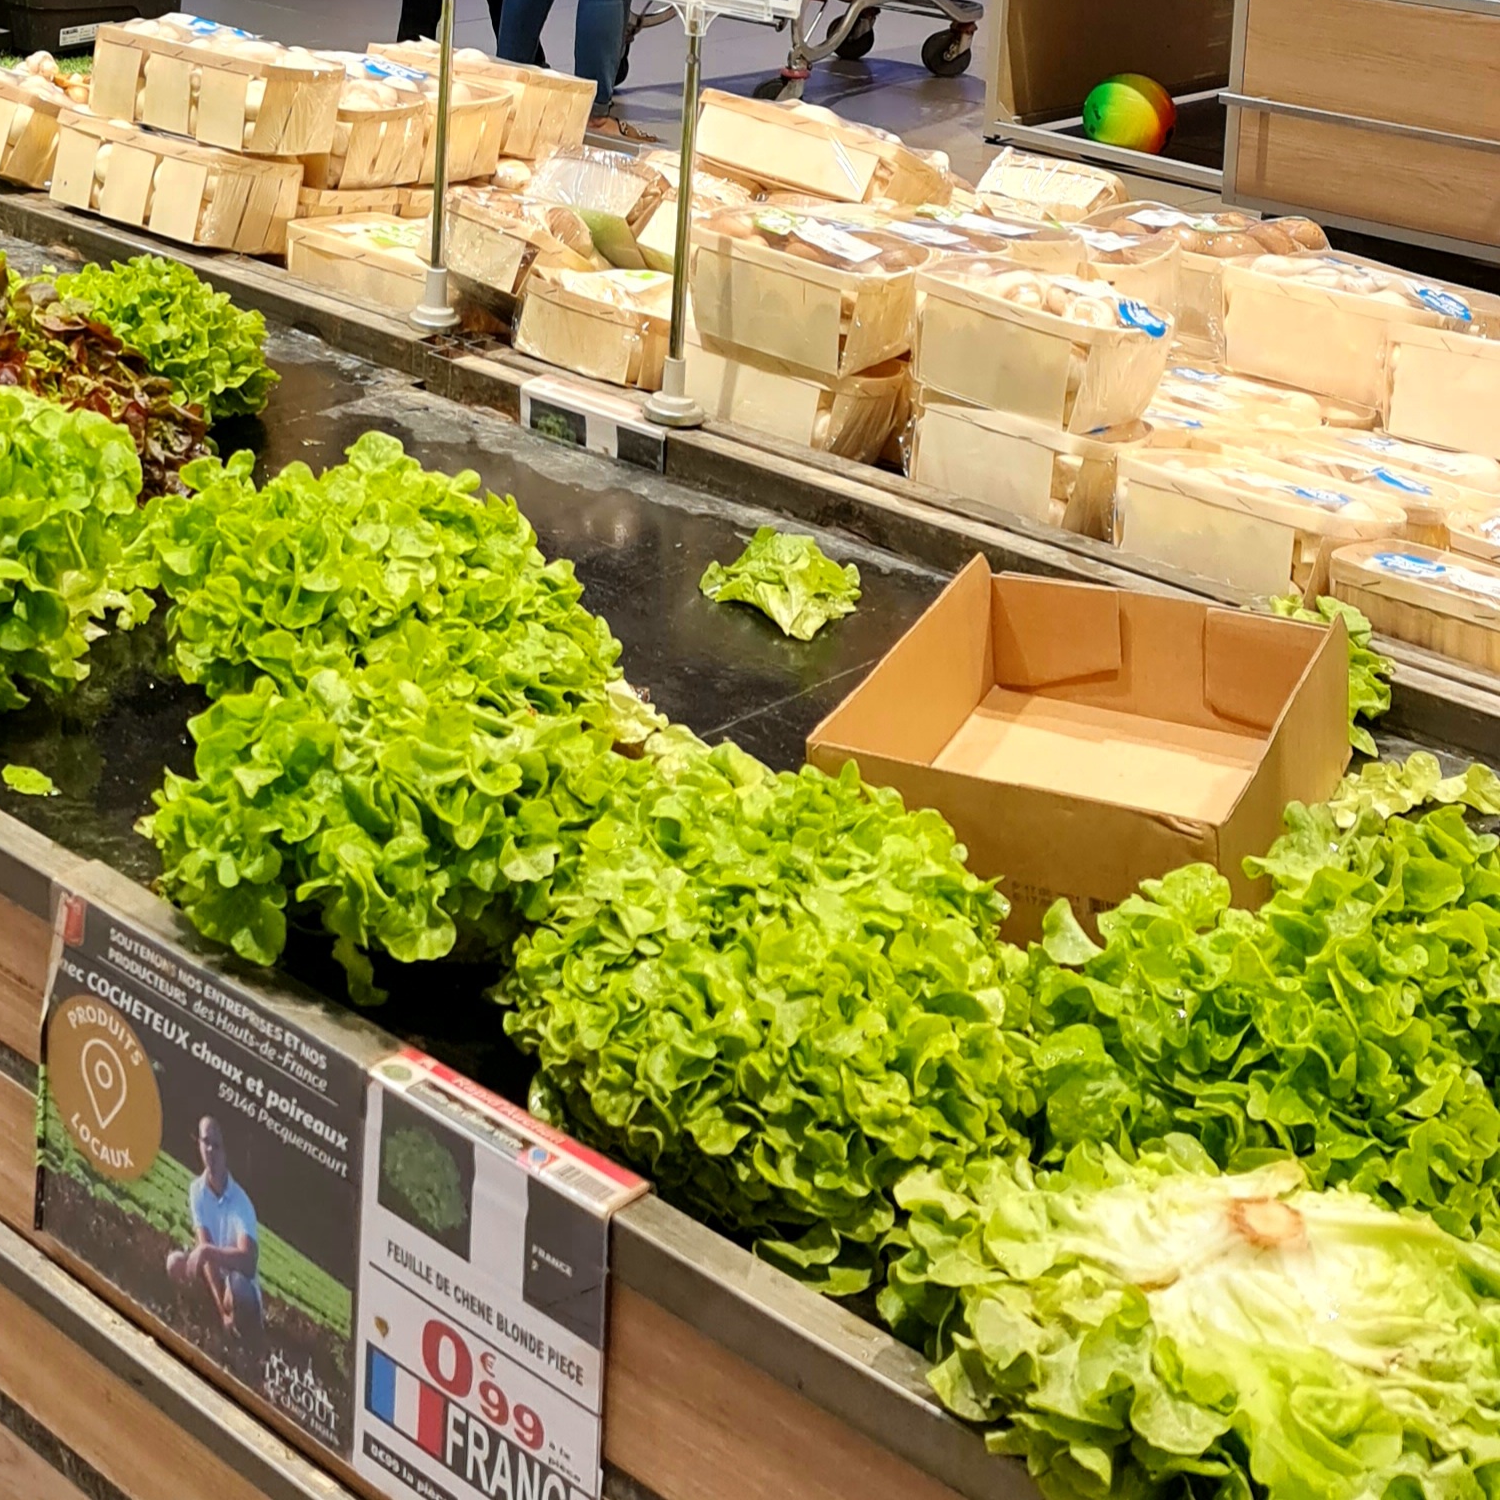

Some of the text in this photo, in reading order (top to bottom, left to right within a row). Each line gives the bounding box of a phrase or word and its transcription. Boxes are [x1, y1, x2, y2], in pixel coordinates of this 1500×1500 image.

[67, 1004, 143, 1067] PRODUITS
[108, 947, 328, 1093] PRODUCTEURS des Hauts-de-France
[110, 927, 328, 1070] SOUTENONS NOS ENTREPRISES ET NOS
[86, 971, 191, 1050] COCHETEUX
[191, 1041, 243, 1085] choux
[245, 1075, 264, 1098] et
[266, 1088, 348, 1153] poireaux
[70, 1112, 135, 1169] LOCAUX
[218, 1082, 348, 1179] 59146 Pecquencourt
[531, 1243, 573, 1278] FRANCE
[387, 1239, 584, 1387] FEUILLE DE CHENE BLONDE PIECE
[421, 1318, 474, 1399] 0
[478, 1379, 545, 1451] 99
[402, 1465, 414, 1485] la
[445, 1400, 578, 1500] FRAN
